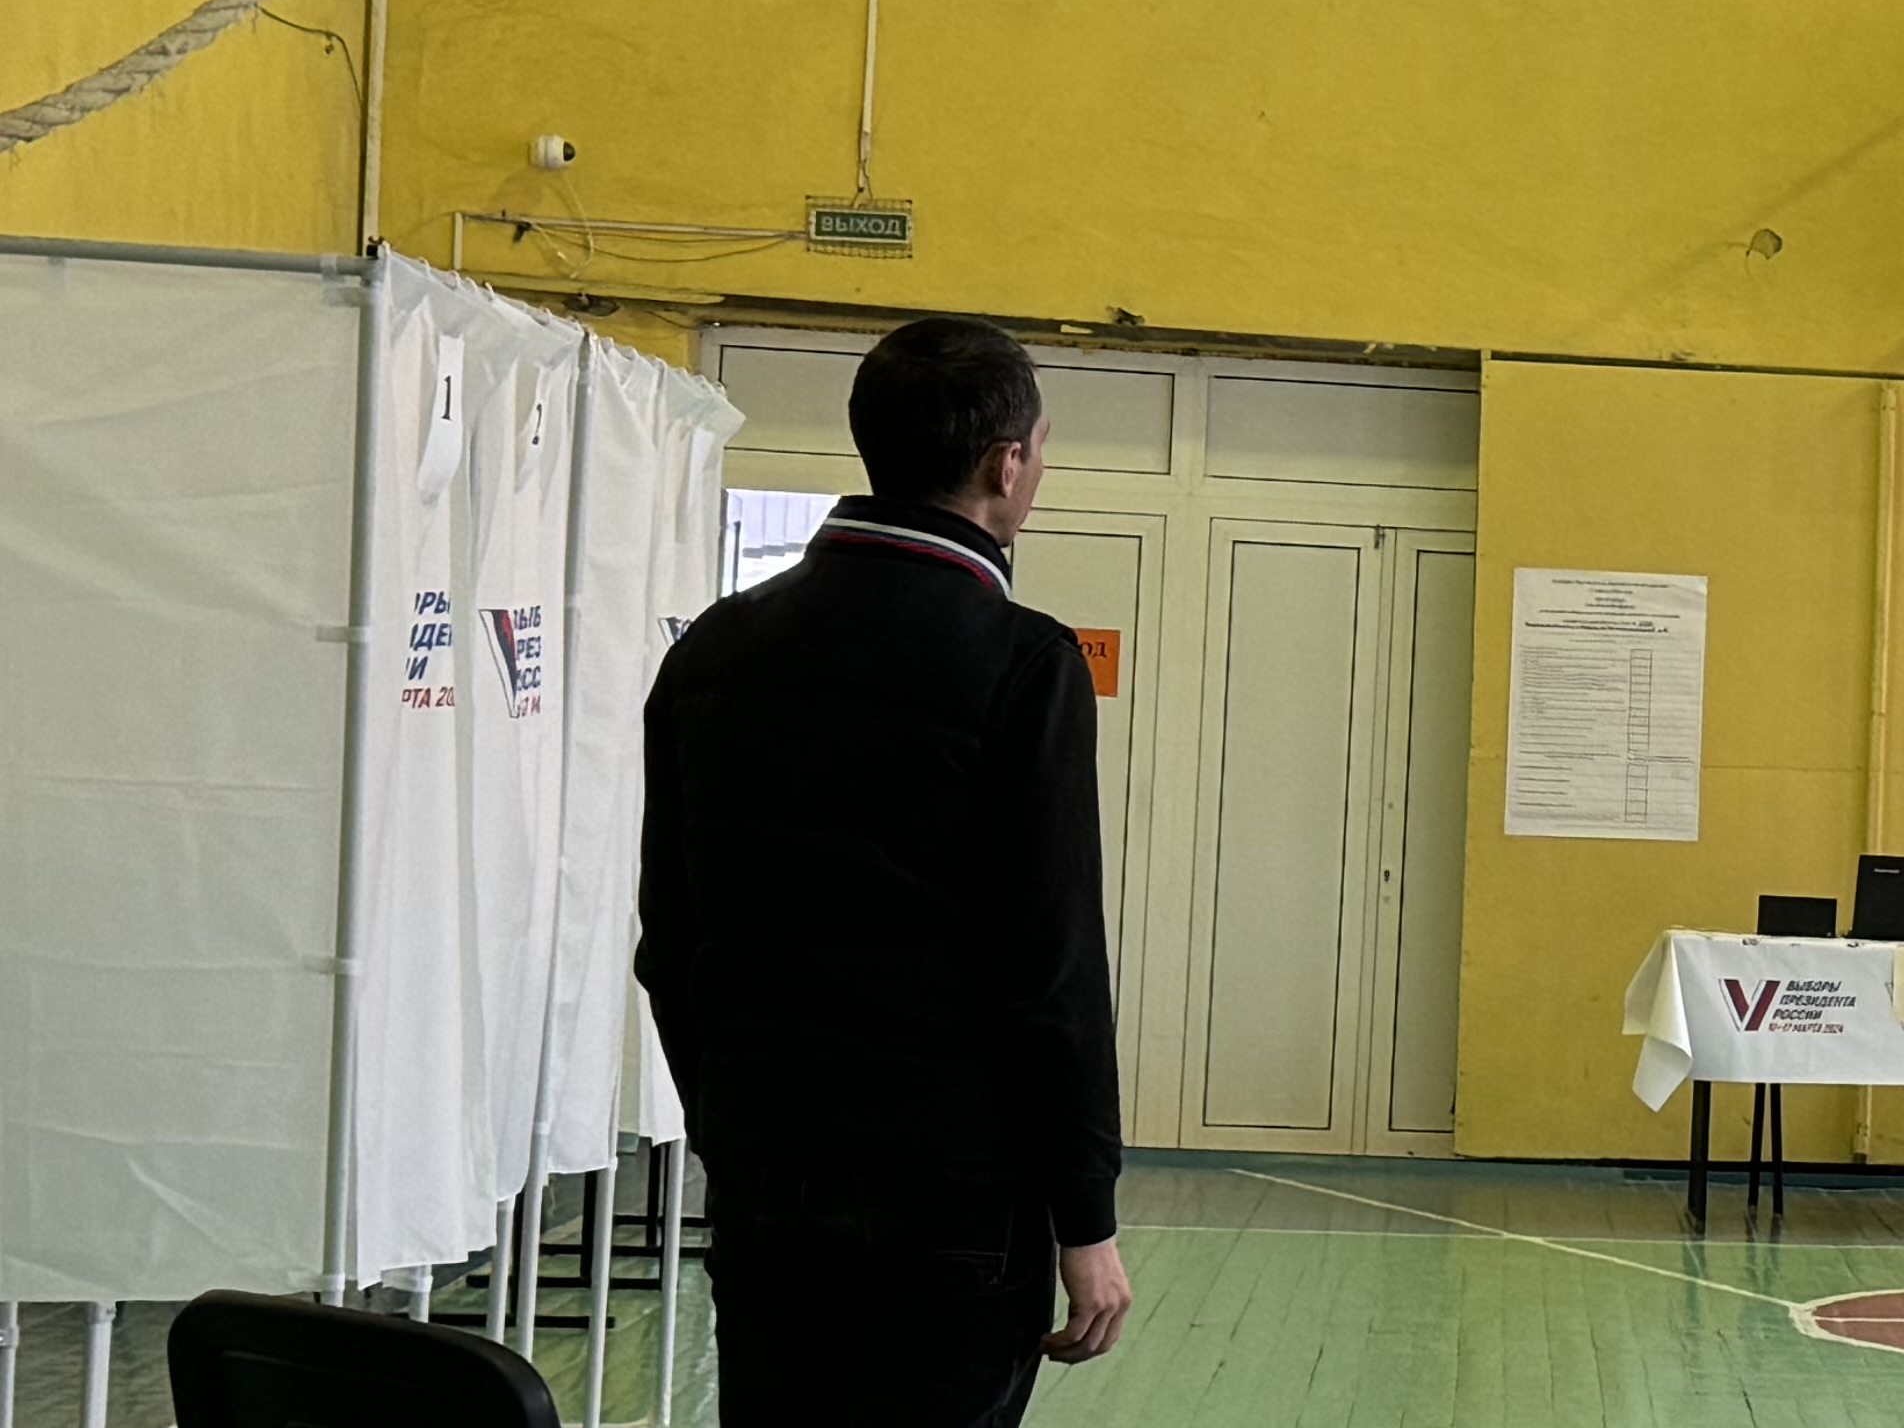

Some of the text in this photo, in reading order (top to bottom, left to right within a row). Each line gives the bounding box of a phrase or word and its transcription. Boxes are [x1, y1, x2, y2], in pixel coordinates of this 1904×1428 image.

[821, 216, 902, 236] ВЫХОД
[441, 375, 452, 421] 1
[1786, 979, 1842, 991] ВЫБОРЫ
